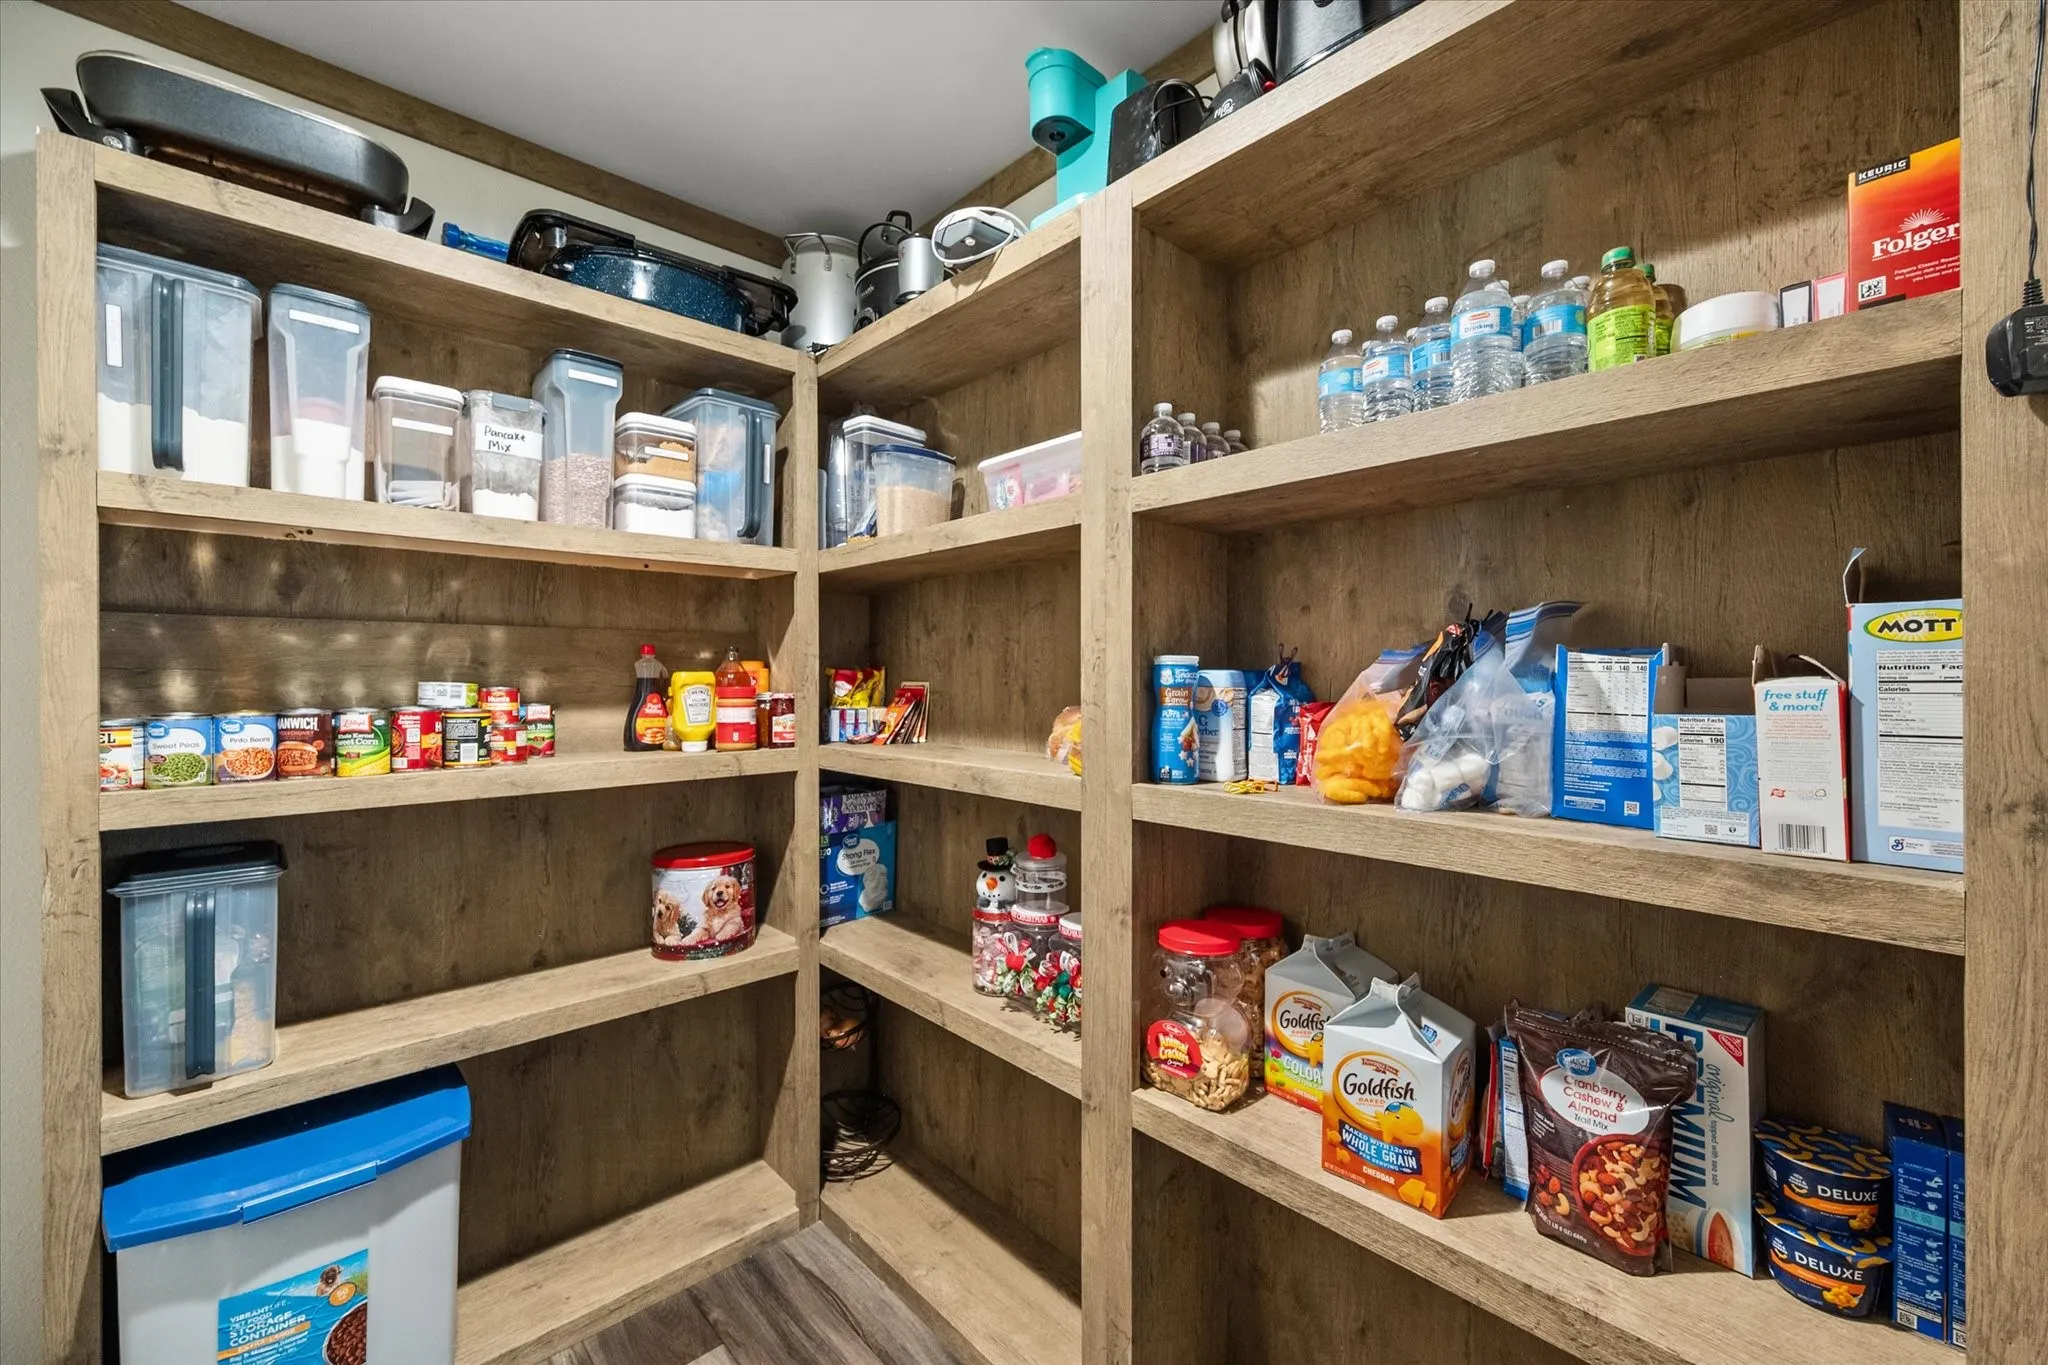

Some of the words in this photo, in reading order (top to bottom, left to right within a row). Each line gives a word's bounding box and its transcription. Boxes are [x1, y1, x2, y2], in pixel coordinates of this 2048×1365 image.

[1858, 159, 1908, 180] KEURIG
[1464, 323, 1494, 333] Drinking
[484, 424, 525, 442] Pancake
[488, 440, 511, 453] Mix
[1165, 688, 1189, 698] Grain
[1763, 689, 1793, 702] free
[1795, 688, 1829, 701] stuff
[1768, 701, 1780, 711] &
[1782, 702, 1824, 711] more!
[841, 850, 863, 861] Strong
[863, 848, 876, 856] Flex
[1158, 1032, 1189, 1054] Animal
[1159, 1046, 1190, 1065] Crackers
[1562, 1052, 1591, 1067] Great
[1567, 1061, 1590, 1072] Value
[1343, 1072, 1416, 1101] Goldfish
[1563, 1074, 1628, 1104] Cranberry,
[1699, 1063, 1735, 1123] original
[1358, 1097, 1386, 1105] BAKED
[1563, 1086, 1612, 1108] Cashew
[1615, 1101, 1625, 1112] &
[1568, 1100, 1617, 1123] Almond
[1574, 1113, 1591, 1124] Trail
[1592, 1119, 1609, 1131] Mix
[1344, 1124, 1369, 1140] BAKED
[1369, 1137, 1390, 1150] WITH
[1708, 1120, 1717, 1144] topped
[1342, 1129, 1378, 1157] WHOLE
[1382, 1149, 1417, 1170] GRAIN
[1358, 1151, 1371, 1161] PER
[1371, 1157, 1399, 1171] SERVING
[1362, 1165, 1395, 1185] CHEDDAR
[1817, 1184, 1878, 1202] DELUXE
[1794, 1251, 1864, 1281] DELUXE
[229, 1306, 268, 1324] VIBRANT
[247, 1312, 272, 1325] FOOD
[229, 1311, 293, 1339] STORAGE
[229, 1314, 306, 1347] CONTAINER
